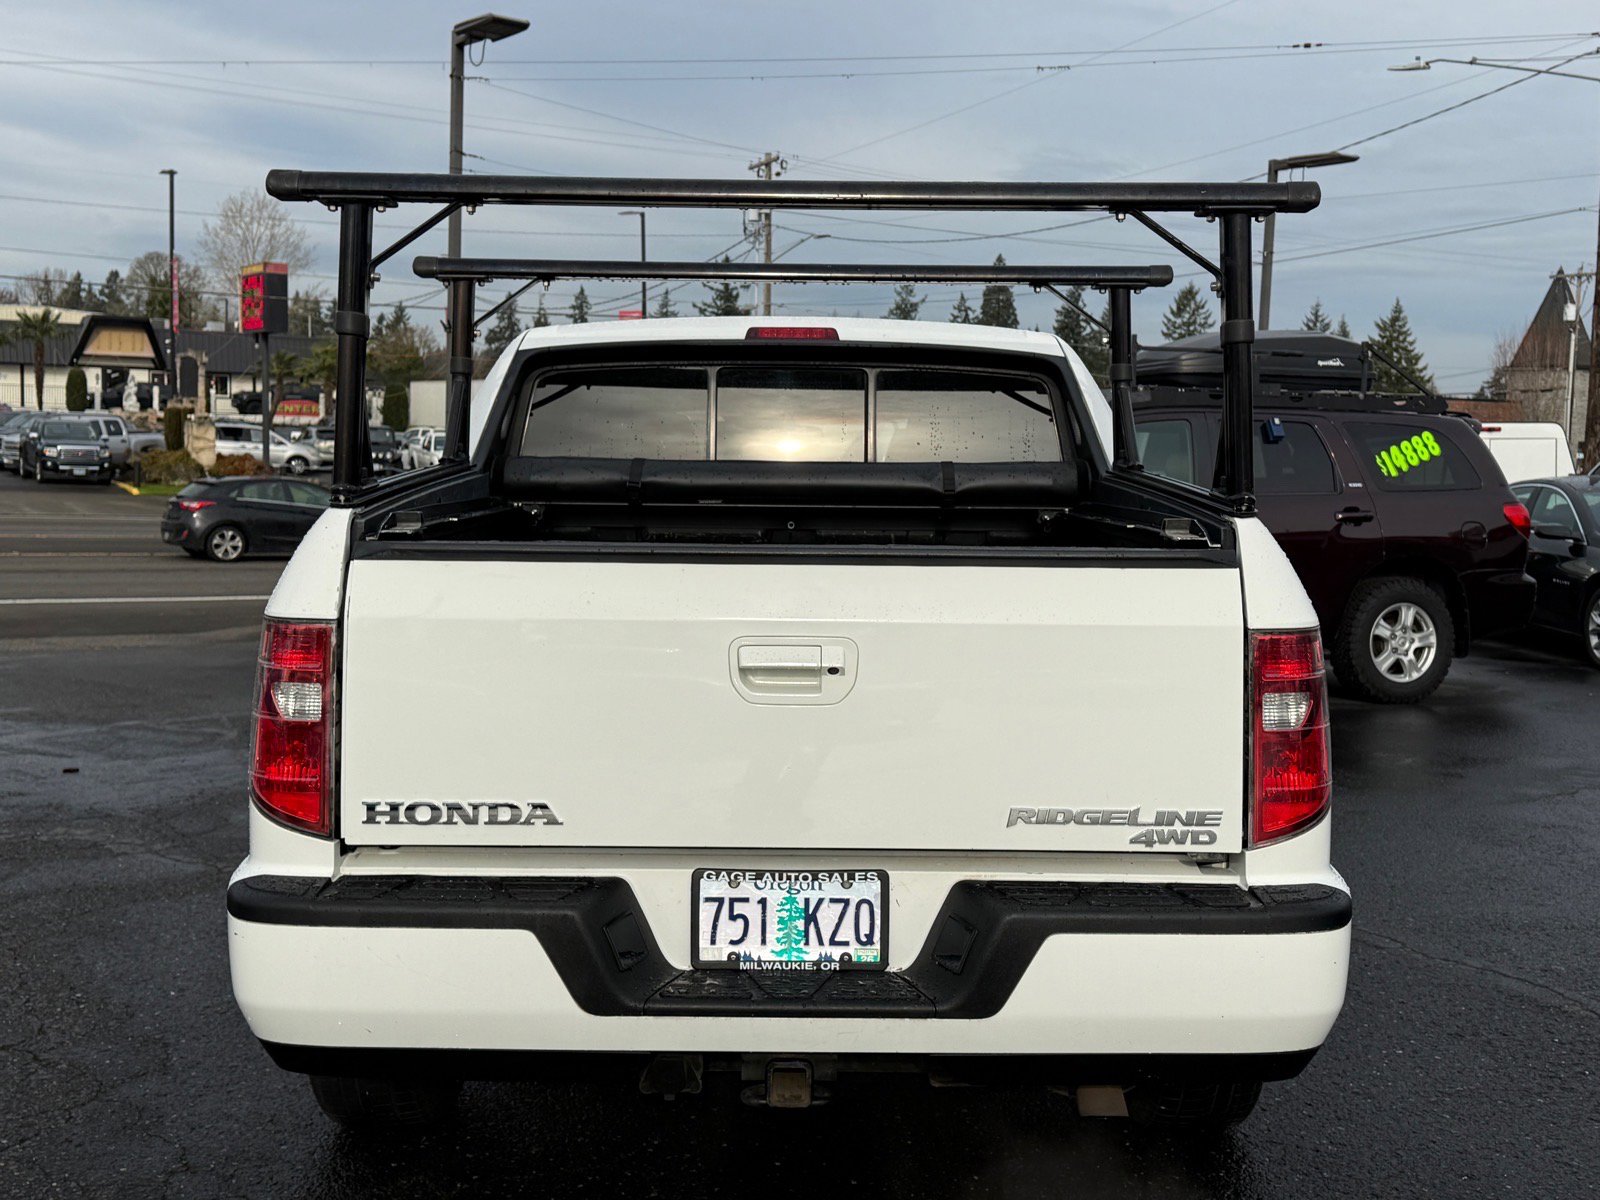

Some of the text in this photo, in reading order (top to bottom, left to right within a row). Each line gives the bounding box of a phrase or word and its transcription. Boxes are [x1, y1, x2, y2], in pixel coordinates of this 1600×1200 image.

[1375, 431, 1441, 477] $14888
[361, 801, 564, 826] HONDA
[1006, 806, 1223, 828] RIDGELINE
[1129, 828, 1217, 848] 4WD
[702, 870, 879, 883] GAGE AUTO SALES
[703, 897, 876, 946] 751 KZQ
[739, 961, 840, 971] MILWAUKIE, OR
